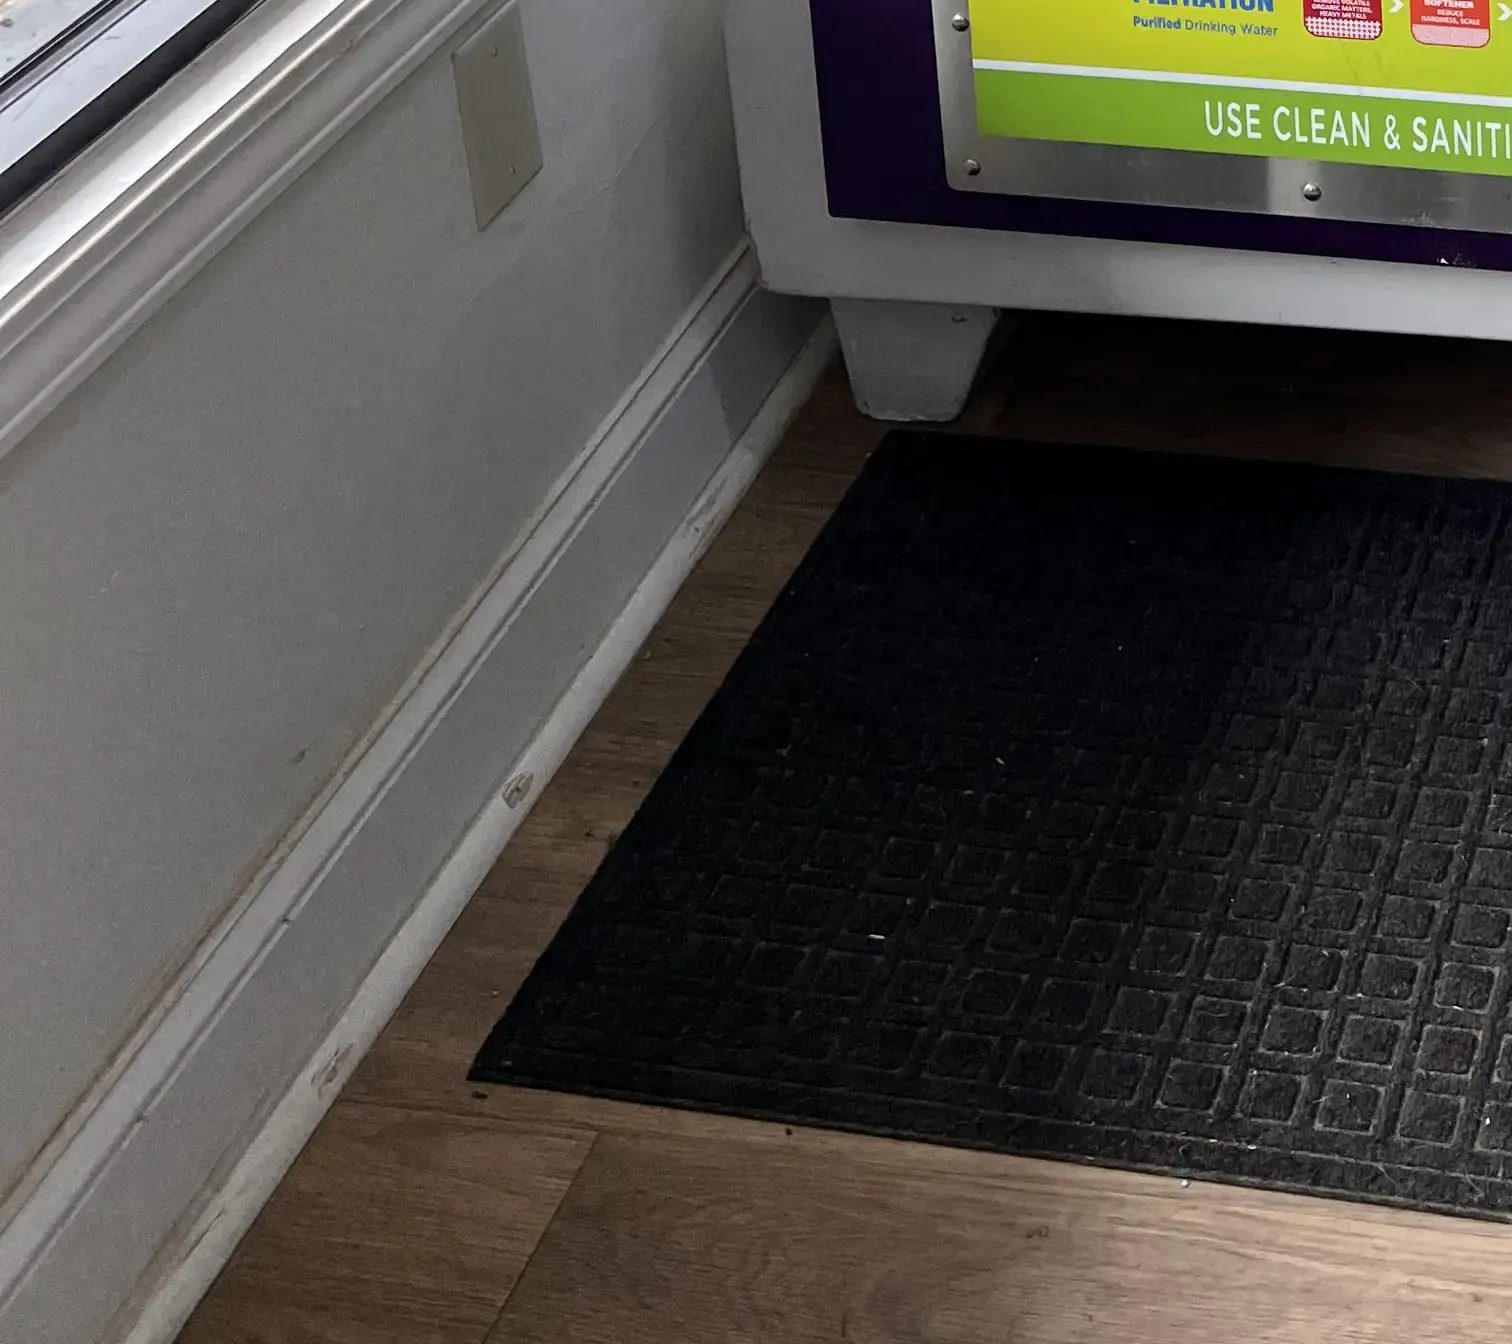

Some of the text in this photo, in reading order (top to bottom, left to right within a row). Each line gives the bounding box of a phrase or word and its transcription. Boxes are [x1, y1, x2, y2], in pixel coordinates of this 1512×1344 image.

[1133, 16, 1278, 37] Purified Drinking Water
[1204, 100, 1261, 139] USE
[1273, 107, 1370, 149] CLEAN
[1383, 118, 1402, 151] &
